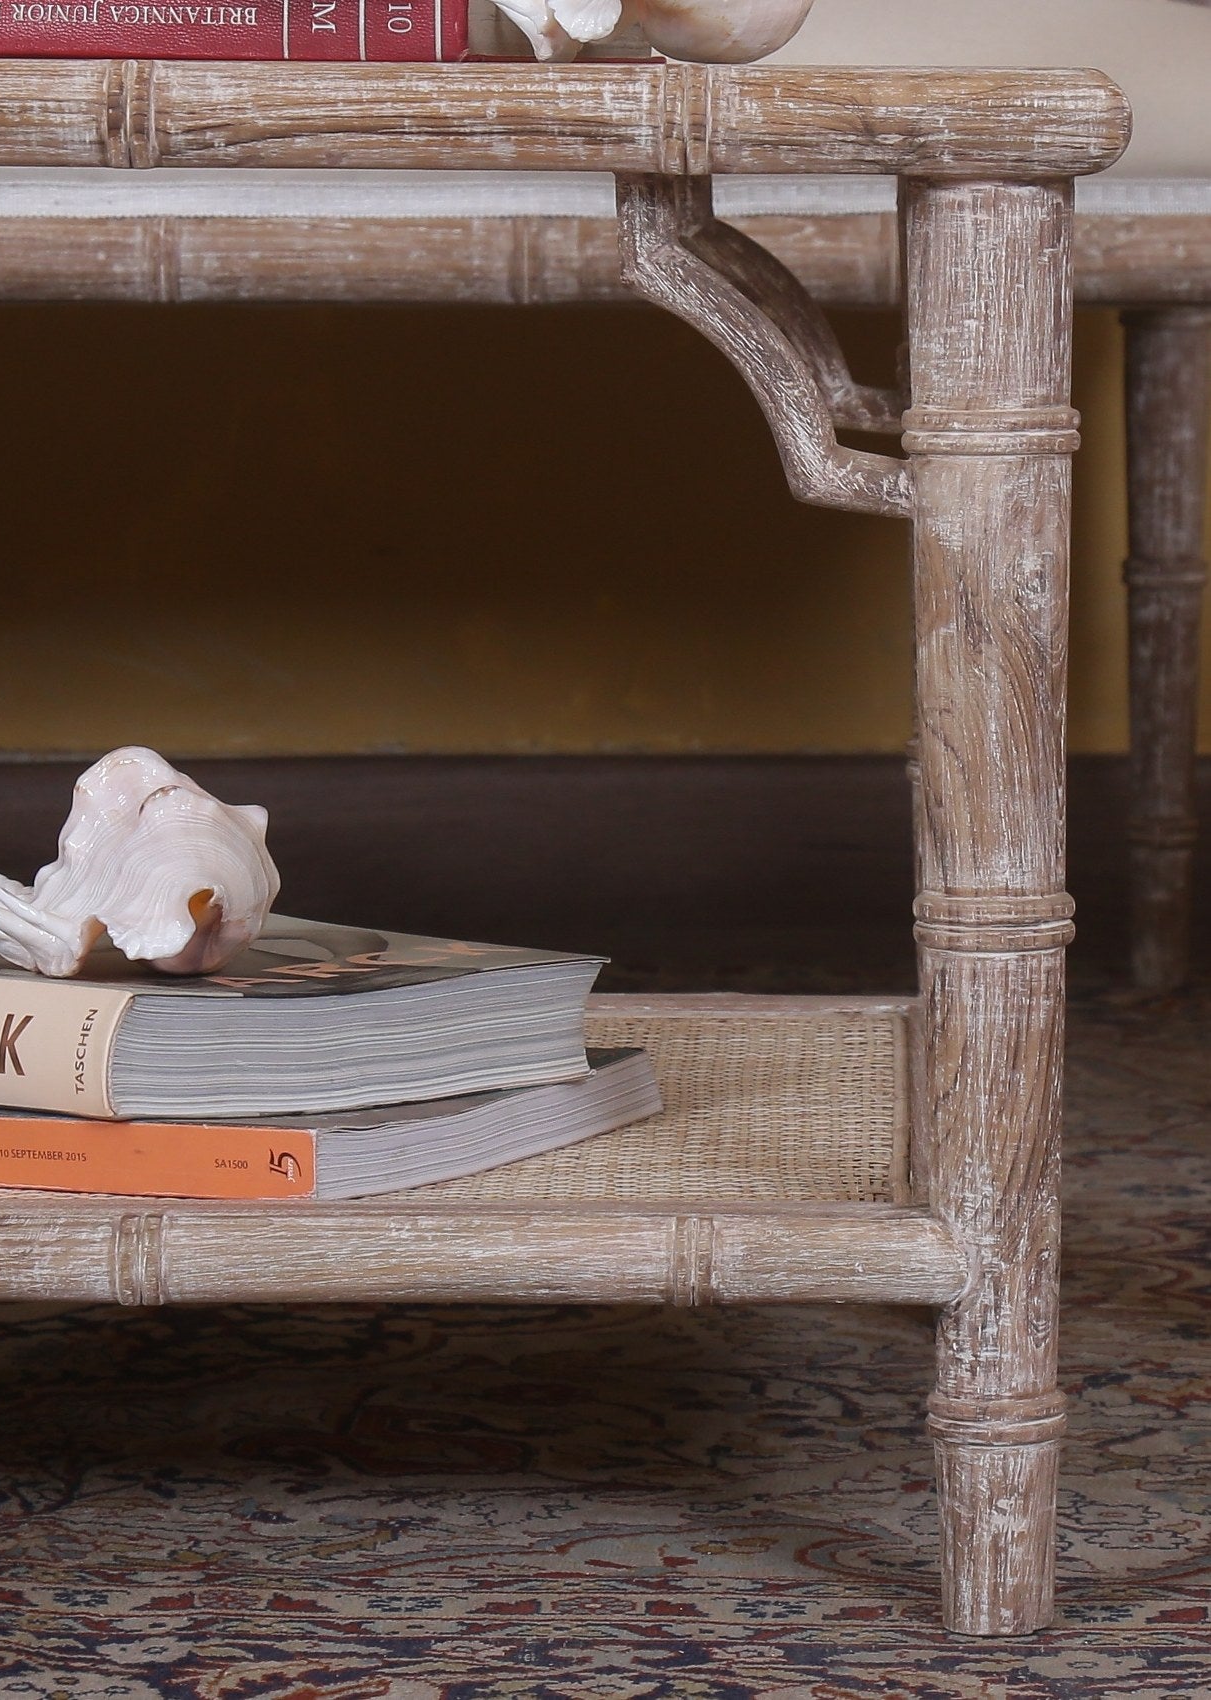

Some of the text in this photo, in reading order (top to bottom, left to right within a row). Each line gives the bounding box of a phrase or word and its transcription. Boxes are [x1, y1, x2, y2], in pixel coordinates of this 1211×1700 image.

[11, 0, 104, 24] JUNIOR
[109, 5, 258, 26] BRITANNICA
[387, 3, 412, 33] 10
[73, 1008, 98, 1095] TASCHEN
[10, 1149, 64, 1161] SEPTEMBER
[65, 1151, 87, 1162] 2015
[214, 1158, 249, 1170] SA1500
